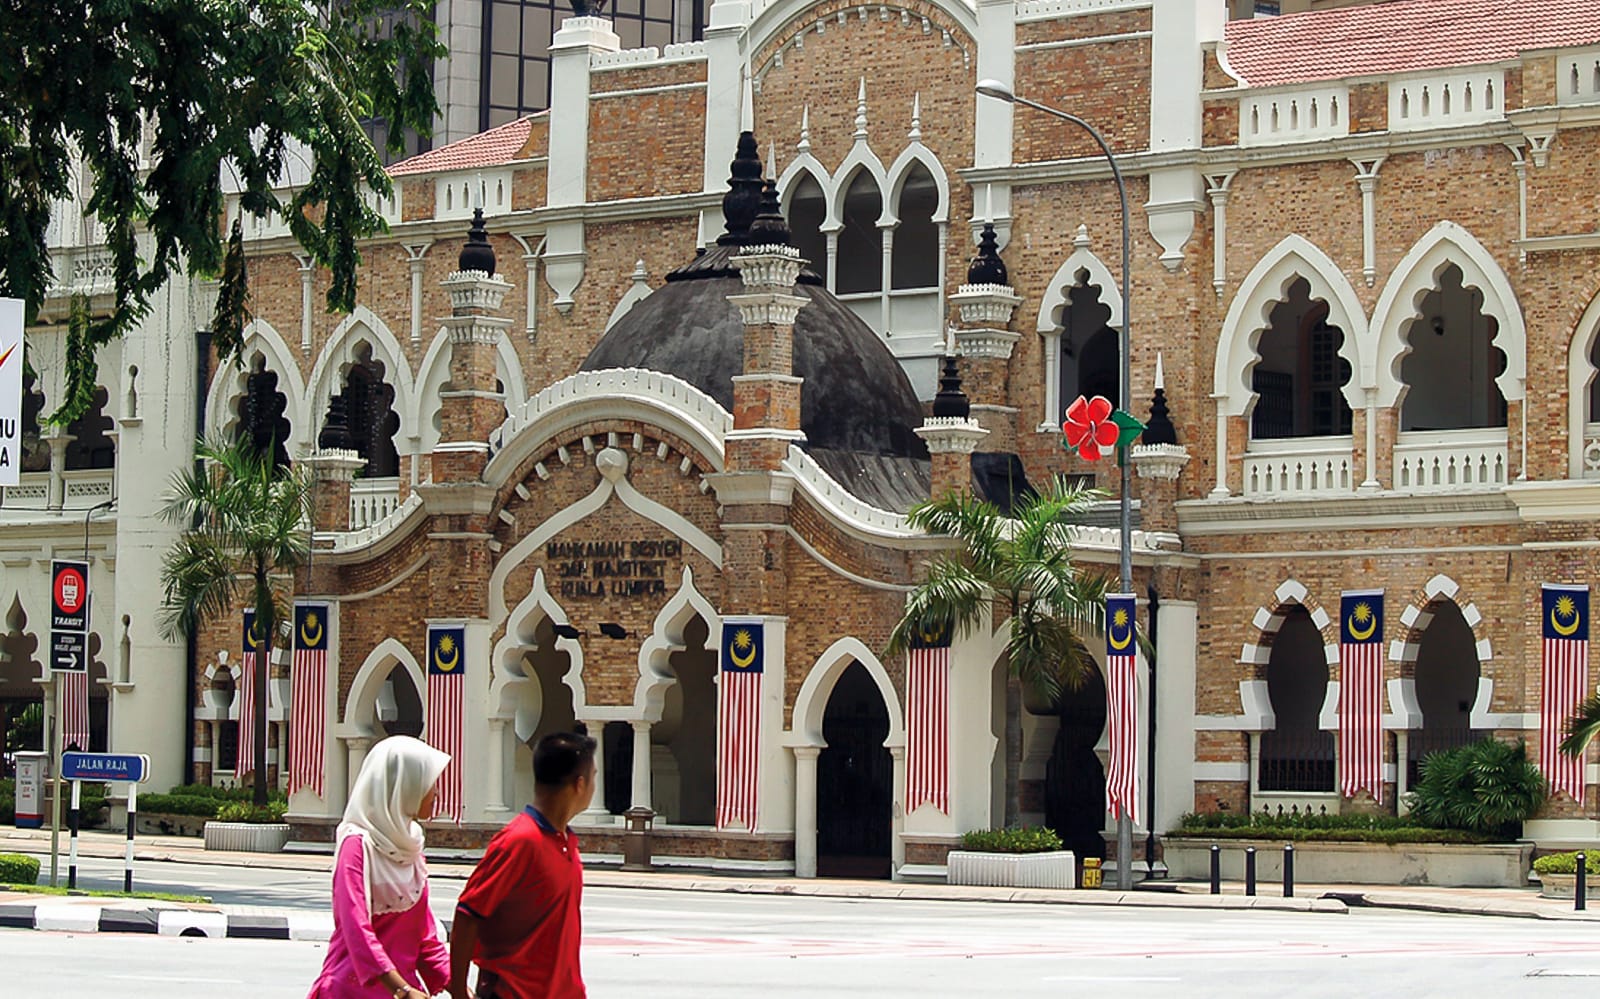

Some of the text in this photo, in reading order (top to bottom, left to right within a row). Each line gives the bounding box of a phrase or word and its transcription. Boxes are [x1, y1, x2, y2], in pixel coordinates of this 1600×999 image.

[547, 540, 682, 558] MAHKAMAH SESYEN
[561, 580, 666, 597] KUALA LUMPUR
[54, 616, 83, 626] TRANSIT
[76, 759, 128, 771] JALAN RAJA
